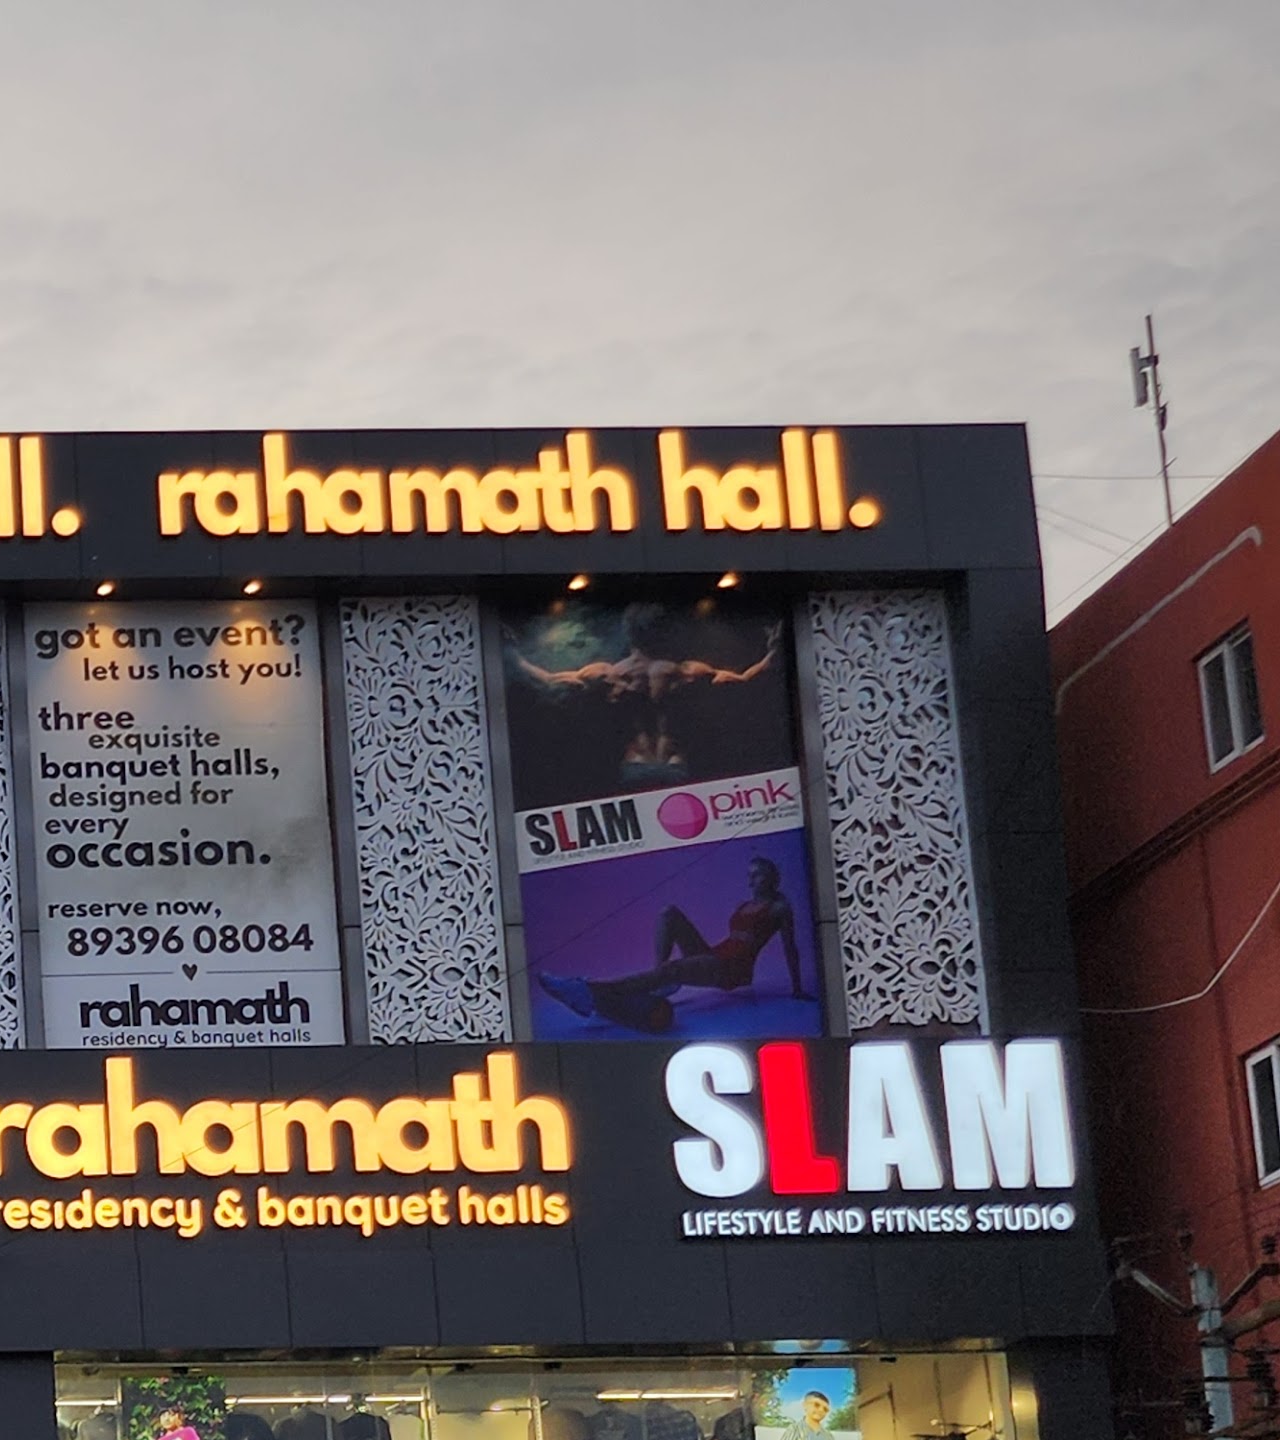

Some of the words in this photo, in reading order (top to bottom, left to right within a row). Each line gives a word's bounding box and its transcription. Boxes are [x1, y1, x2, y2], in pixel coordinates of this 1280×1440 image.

[158, 430, 635, 536] rahamath
[658, 430, 878, 532] hall.
[34, 622, 100, 659] got
[112, 625, 162, 649] an
[173, 614, 305, 649] event?
[83, 657, 119, 682] let
[128, 661, 159, 680] us
[168, 656, 230, 680] host
[238, 654, 302, 685] you!
[38, 701, 135, 732] three
[88, 725, 220, 755] exquisite
[40, 753, 181, 787] banquet
[190, 748, 280, 782] halls,
[48, 782, 181, 813] designed
[190, 781, 234, 805] for
[708, 778, 796, 820] pink
[45, 816, 129, 840] every
[526, 797, 642, 856] SLAM
[46, 827, 271, 869] occasion.
[47, 901, 147, 919] reserve
[155, 899, 222, 920] now,
[67, 926, 184, 957] 89396
[193, 923, 314, 953] 08084
[79, 981, 310, 1029] rahamath
[81, 1030, 167, 1049] residency
[173, 1029, 186, 1044] &
[191, 1028, 264, 1048] banquet
[270, 1027, 311, 1043] halls
[664, 1039, 1077, 1199] SLAM
[213, 1188, 248, 1229] &
[258, 1186, 449, 1239] banquet
[458, 1184, 570, 1227] halls
[682, 1207, 802, 1238] LIFESTYLE
[807, 1206, 866, 1235] AND
[871, 1204, 972, 1234] FITNESS
[976, 1202, 1075, 1232] STUDIO
